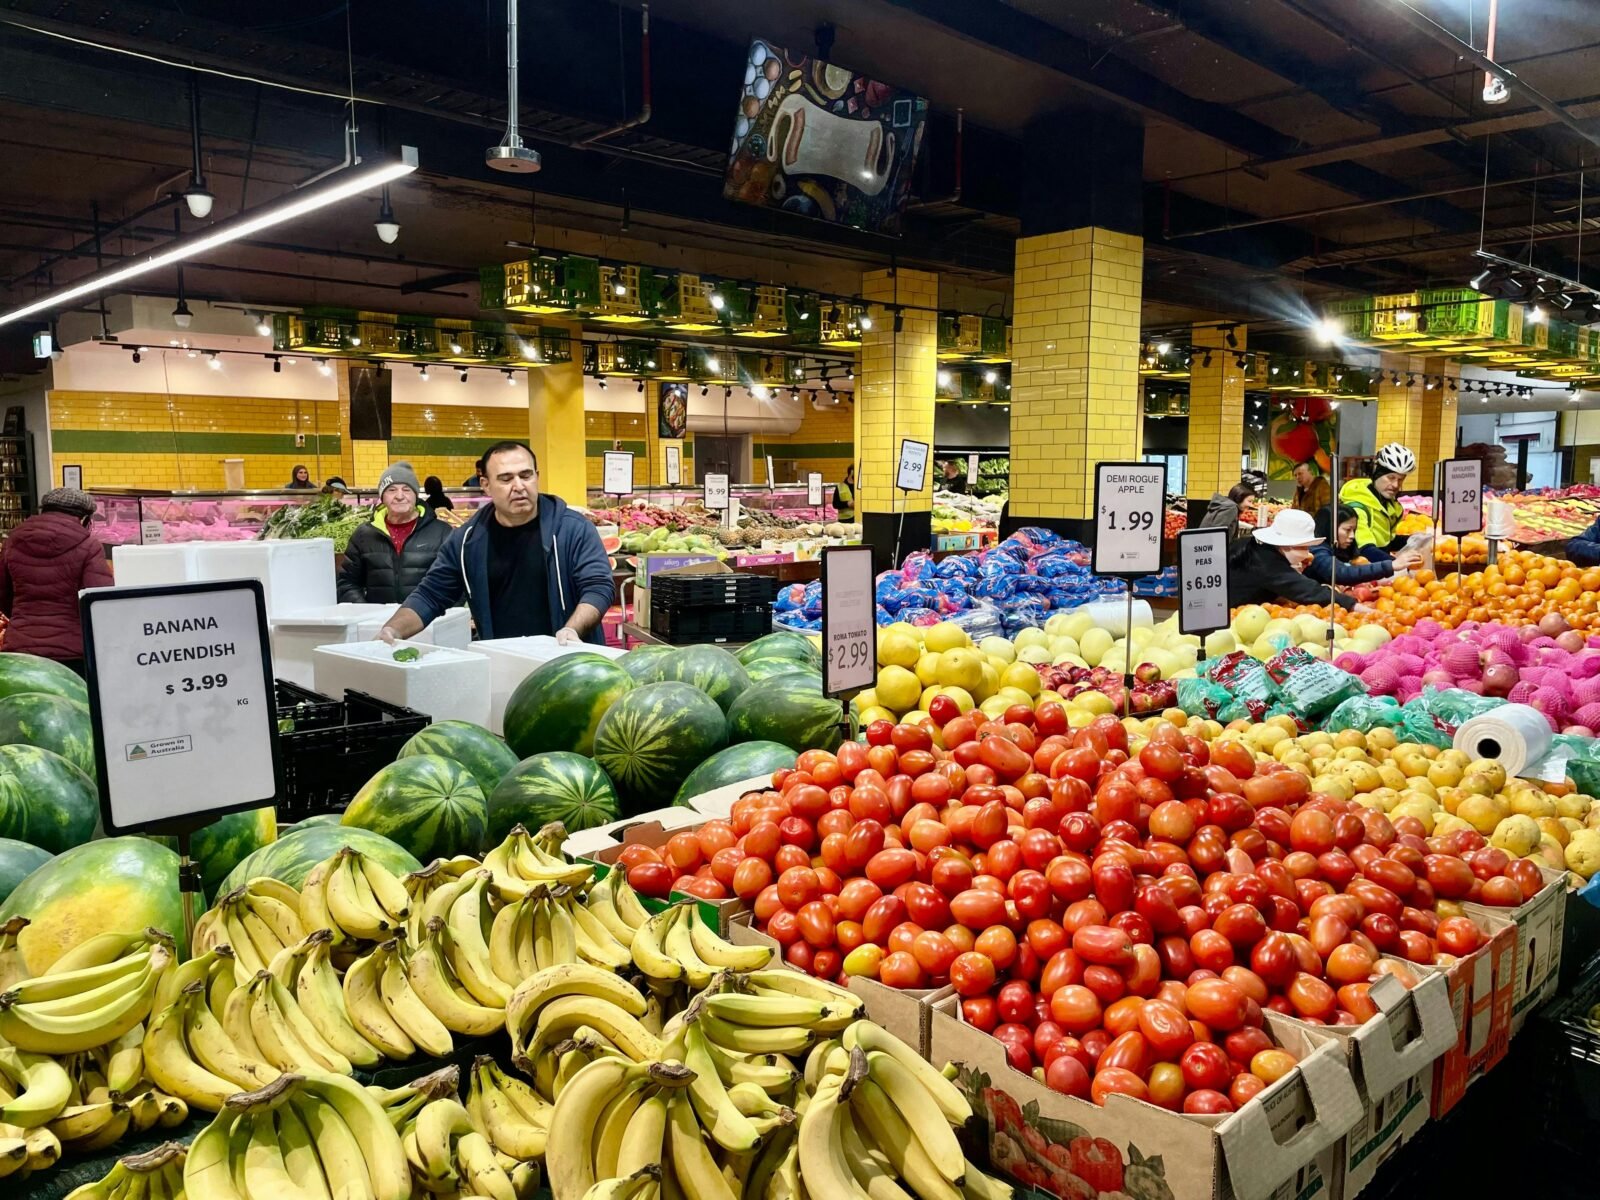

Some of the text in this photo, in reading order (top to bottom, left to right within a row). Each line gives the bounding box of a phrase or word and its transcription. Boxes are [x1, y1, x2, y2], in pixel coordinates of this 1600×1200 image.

[903, 461, 922, 472] 2.99
[1107, 475, 1159, 483] DEMI ROGUE
[1118, 486, 1144, 494] APPLE
[1451, 489, 1476, 504] 1.29
[1108, 510, 1154, 531] 1.99
[1148, 534, 1157, 544] kg
[1193, 545, 1213, 553] SNOW
[1195, 558, 1212, 566] PEAS
[1186, 574, 1222, 591] $ 6.99
[143, 616, 219, 636] BANANA
[834, 630, 867, 641] ROMA TOMATO
[136, 642, 236, 666] CAVENDISH
[838, 641, 868, 669] 2.99
[165, 673, 228, 695] $ 3.99
[236, 698, 249, 706] KG
[150, 740, 176, 749] Grown
[151, 745, 185, 754] Australia
